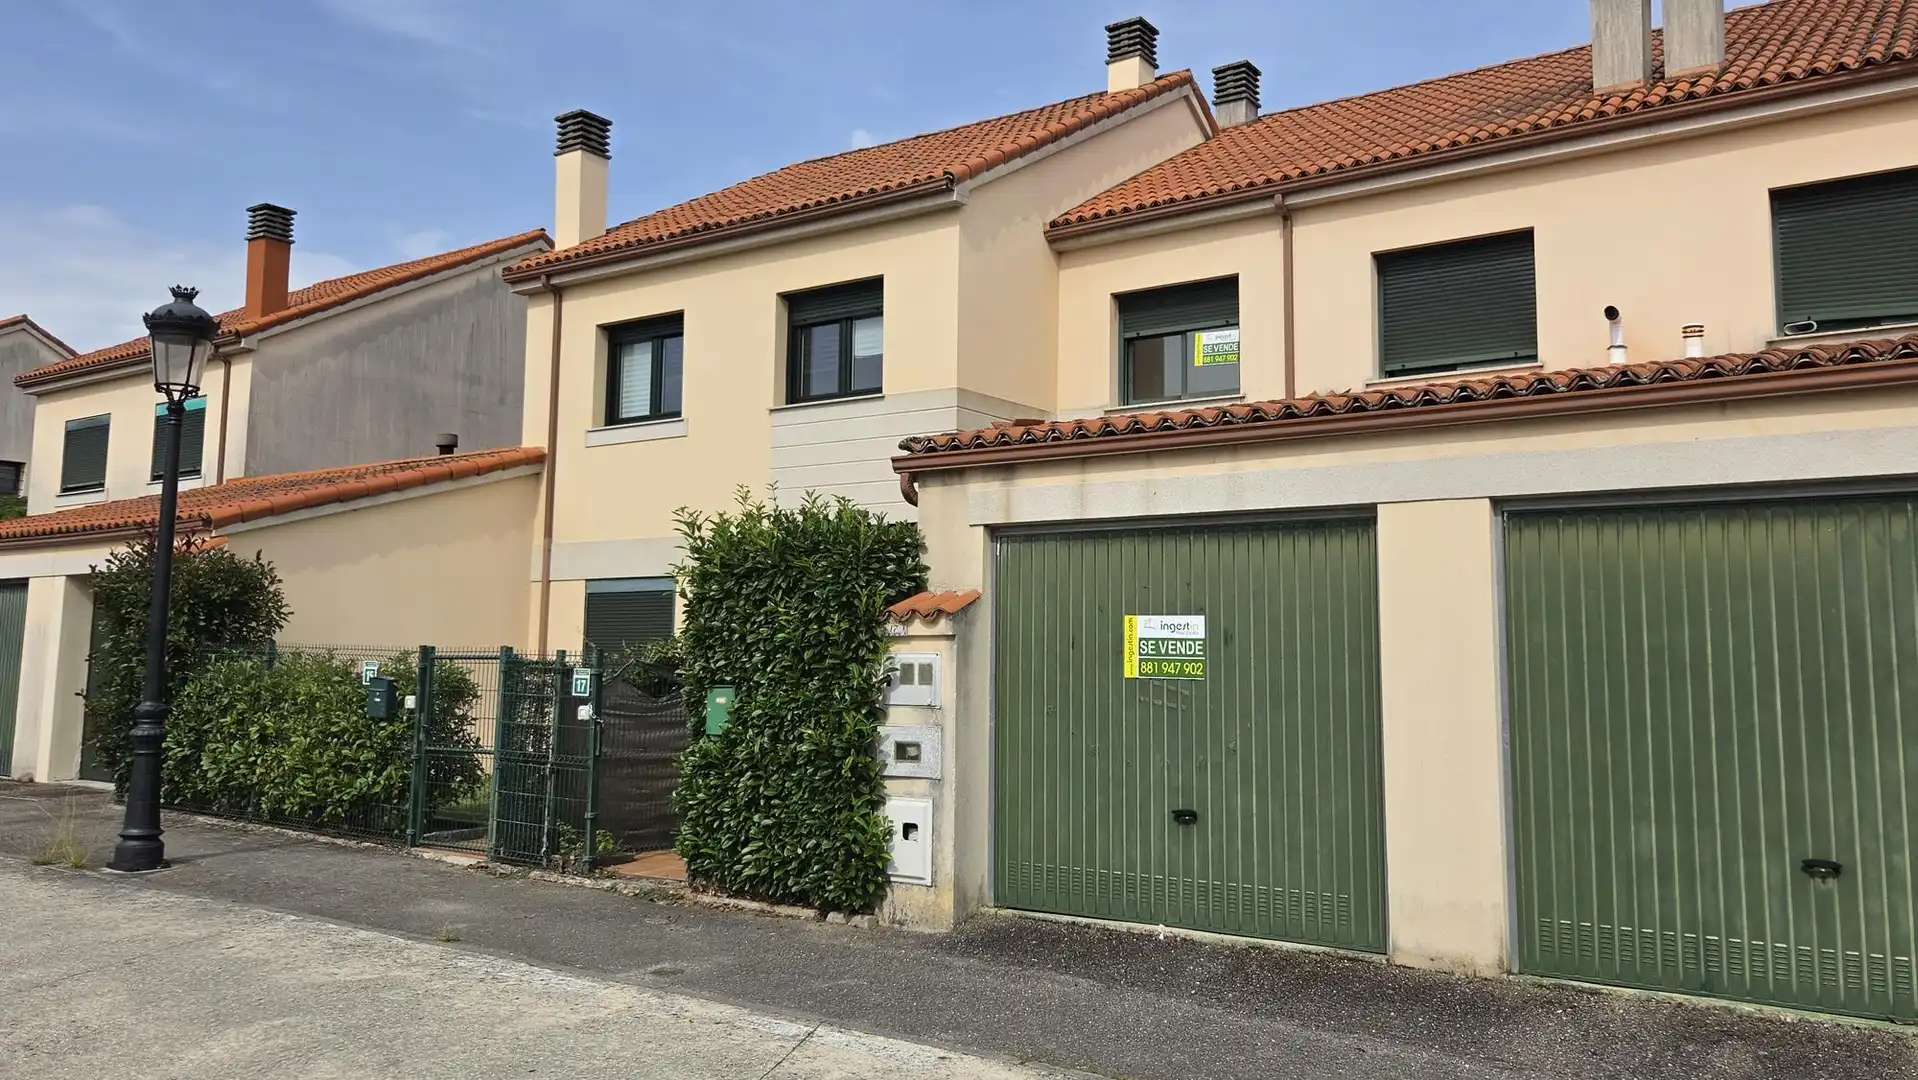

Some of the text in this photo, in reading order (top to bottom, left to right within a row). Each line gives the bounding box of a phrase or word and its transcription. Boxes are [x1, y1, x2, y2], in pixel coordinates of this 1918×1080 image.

[1204, 343, 1238, 353] SE VENDE
[1140, 639, 1203, 655] SE VENDE
[1140, 661, 1204, 675] 881 947 902
[576, 679, 587, 692] 17
